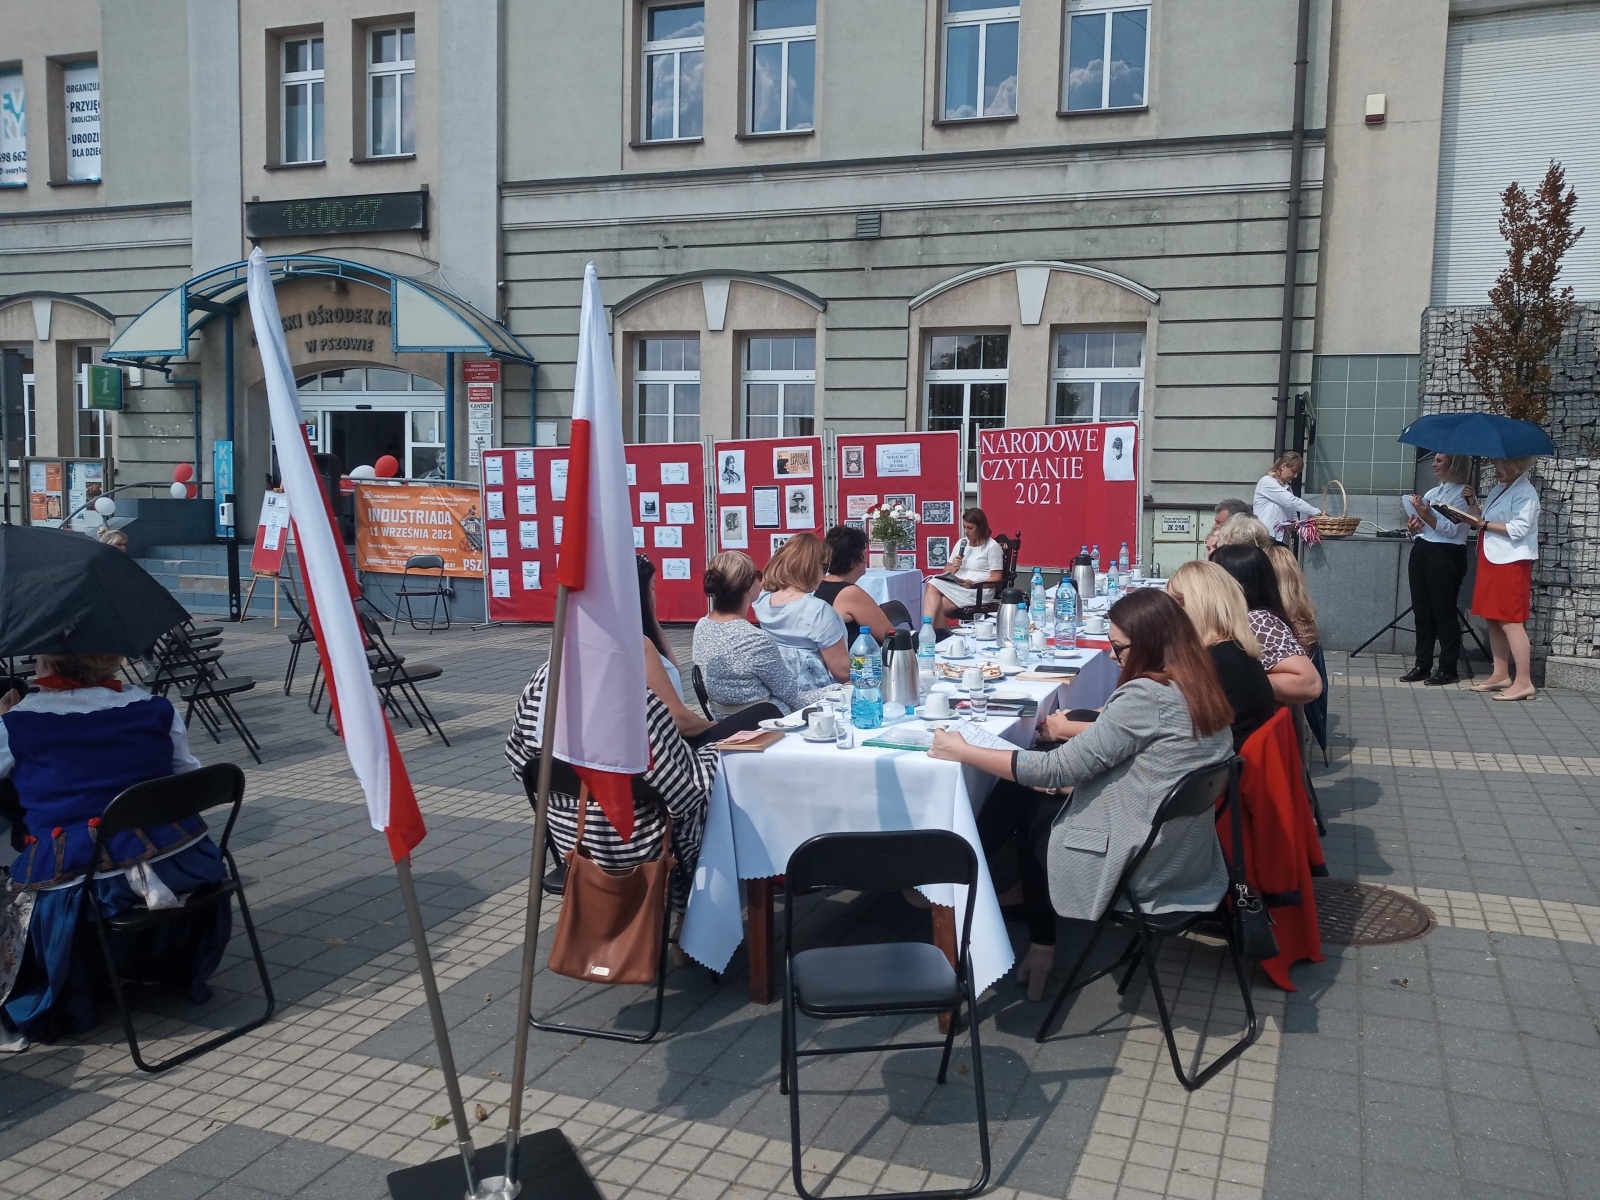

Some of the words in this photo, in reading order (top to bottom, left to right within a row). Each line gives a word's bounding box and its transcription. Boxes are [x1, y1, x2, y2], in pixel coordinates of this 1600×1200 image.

[72, 149, 84, 158] DLA
[283, 199, 383, 230] 13:00:27
[306, 304, 374, 326] OŚRODEK
[305, 340, 318, 353] W
[320, 337, 375, 352] PSZOWIE
[980, 428, 1100, 455] NARODOWE
[980, 456, 1084, 481] CZYTANIE
[1014, 482, 1062, 505] 2021
[368, 508, 452, 526] INDUSTRIADA
[369, 527, 379, 537] 11
[381, 526, 429, 539] WRZEŚNIA
[432, 528, 453, 540] 2021
[463, 558, 484, 572] PSZ
